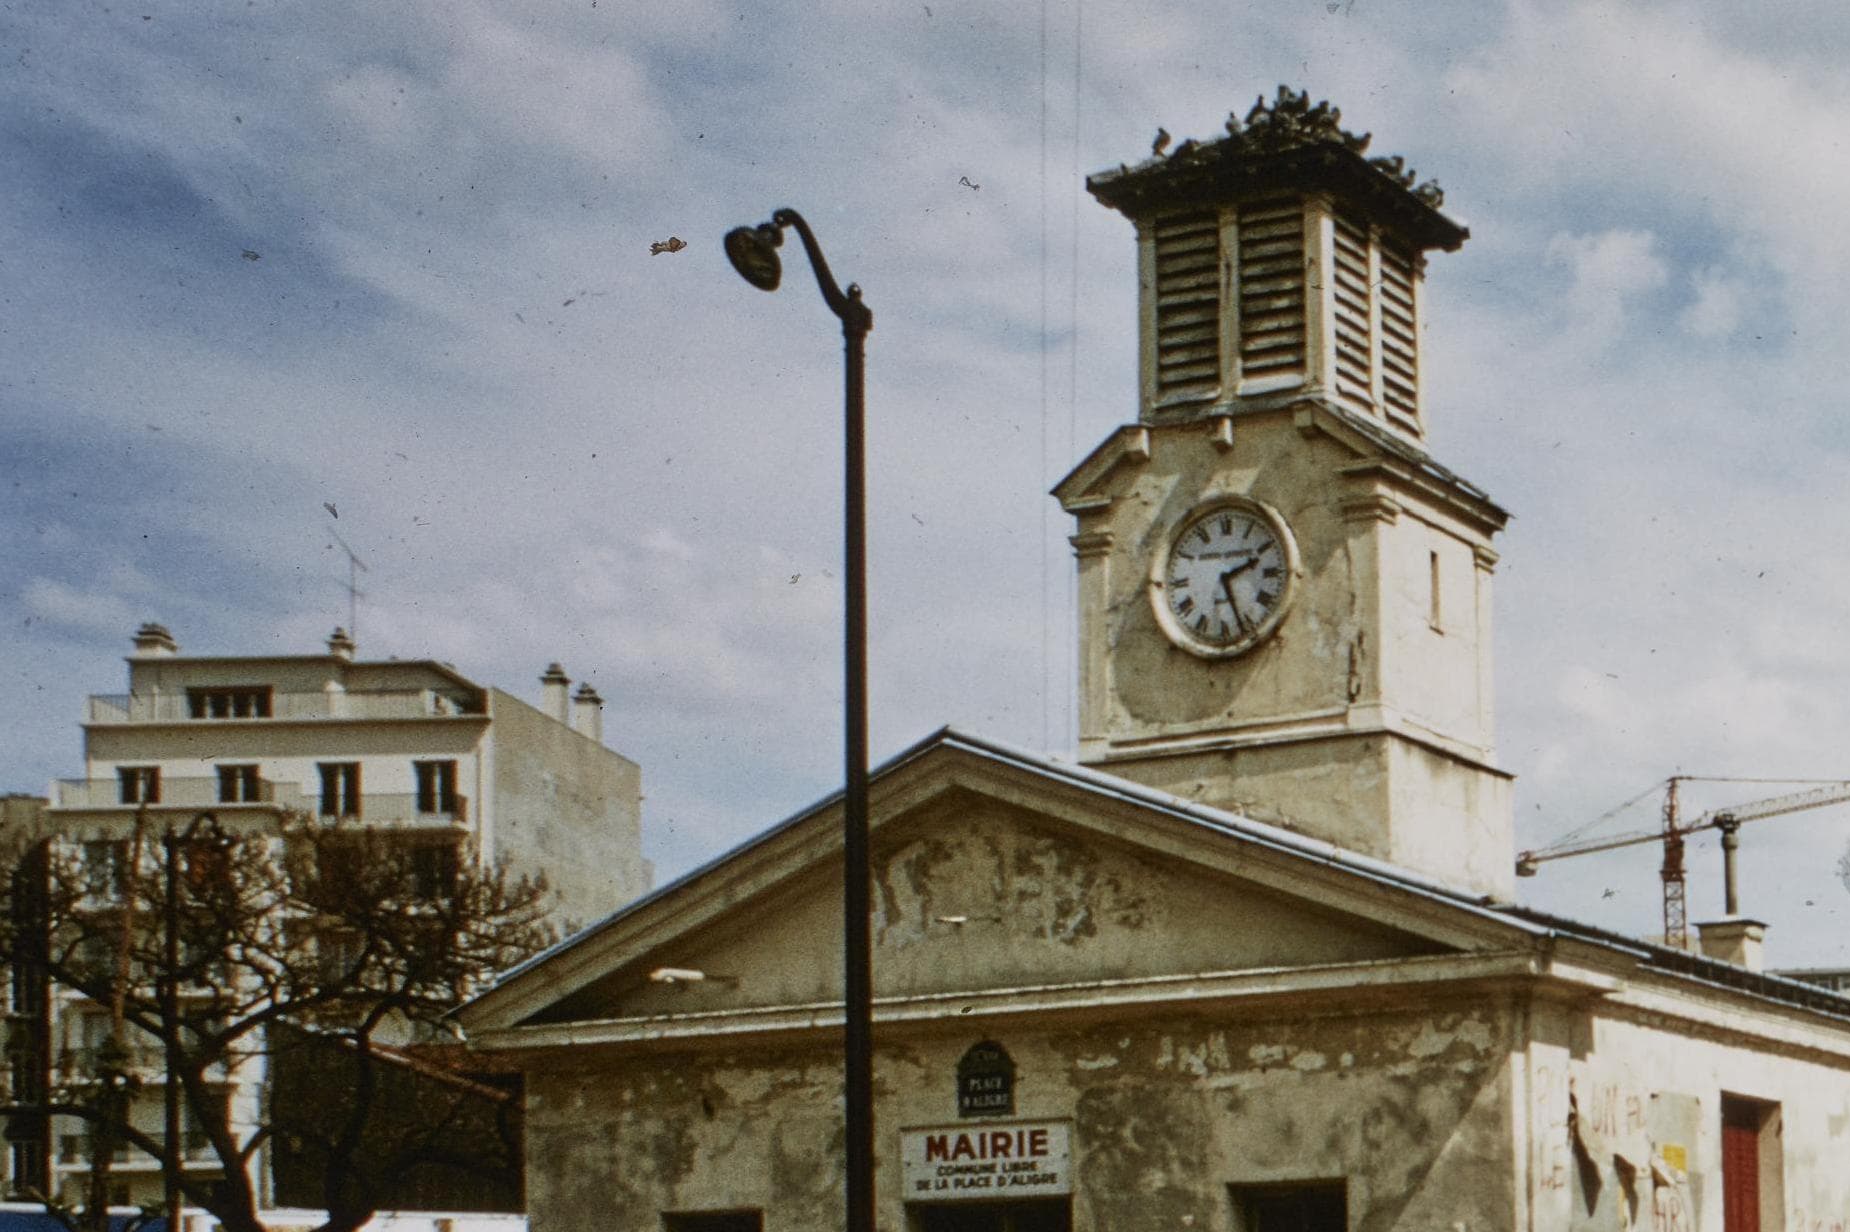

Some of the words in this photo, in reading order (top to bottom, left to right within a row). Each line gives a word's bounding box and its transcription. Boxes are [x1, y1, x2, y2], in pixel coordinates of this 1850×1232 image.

[926, 1130, 1048, 1161] MAIRIE
[937, 1163, 997, 1177] COMMUNE
[1002, 1160, 1038, 1173] LIBRE
[935, 1178, 948, 1190] LA
[954, 1176, 992, 1189] PLACE
[997, 1172, 1057, 1187] D'ALIGRE
